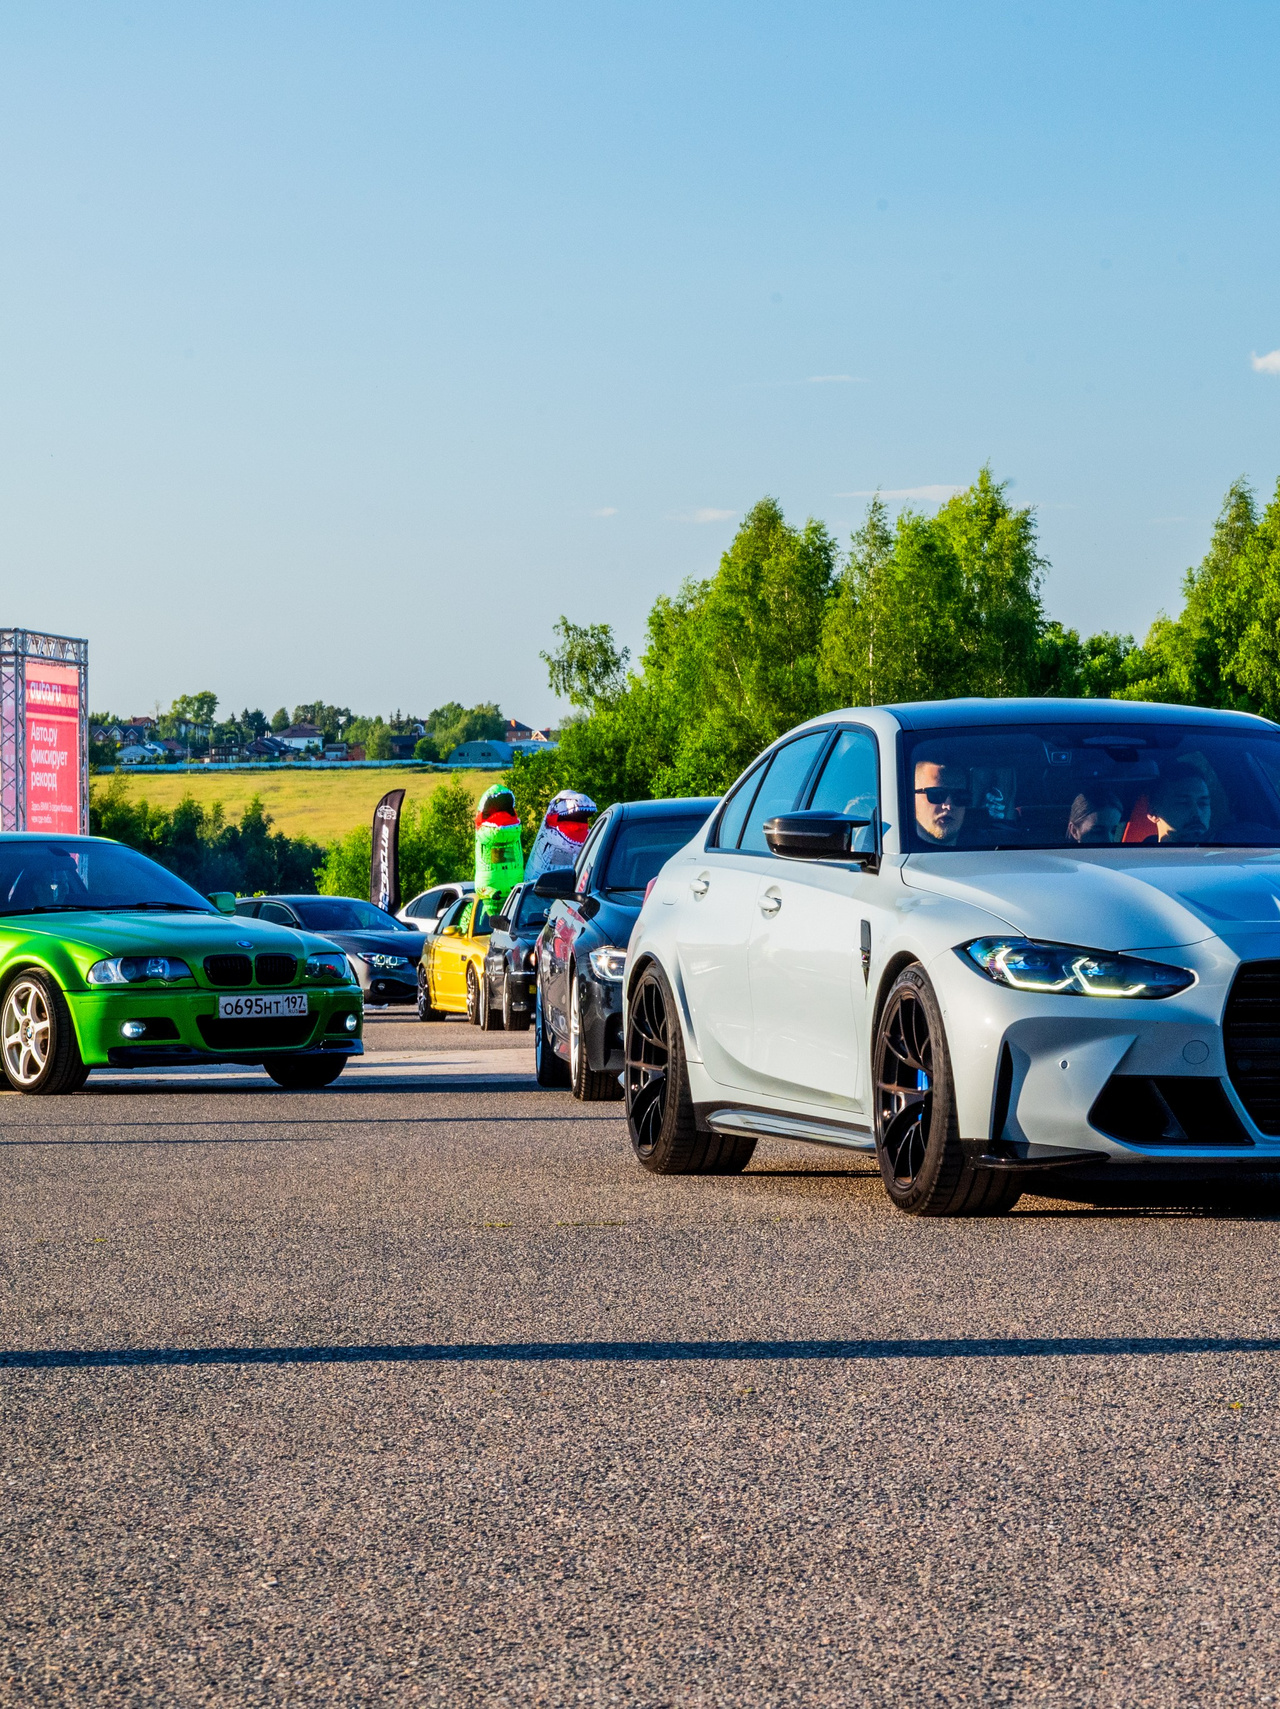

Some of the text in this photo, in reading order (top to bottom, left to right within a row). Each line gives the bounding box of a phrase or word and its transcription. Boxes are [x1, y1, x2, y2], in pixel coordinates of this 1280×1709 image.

[30, 680, 62, 702] auto.ru
[30, 721, 58, 747] Авто.ру
[30, 744, 68, 770] фиксирует
[30, 771, 58, 792] рекорд
[284, 996, 304, 1009] 197
